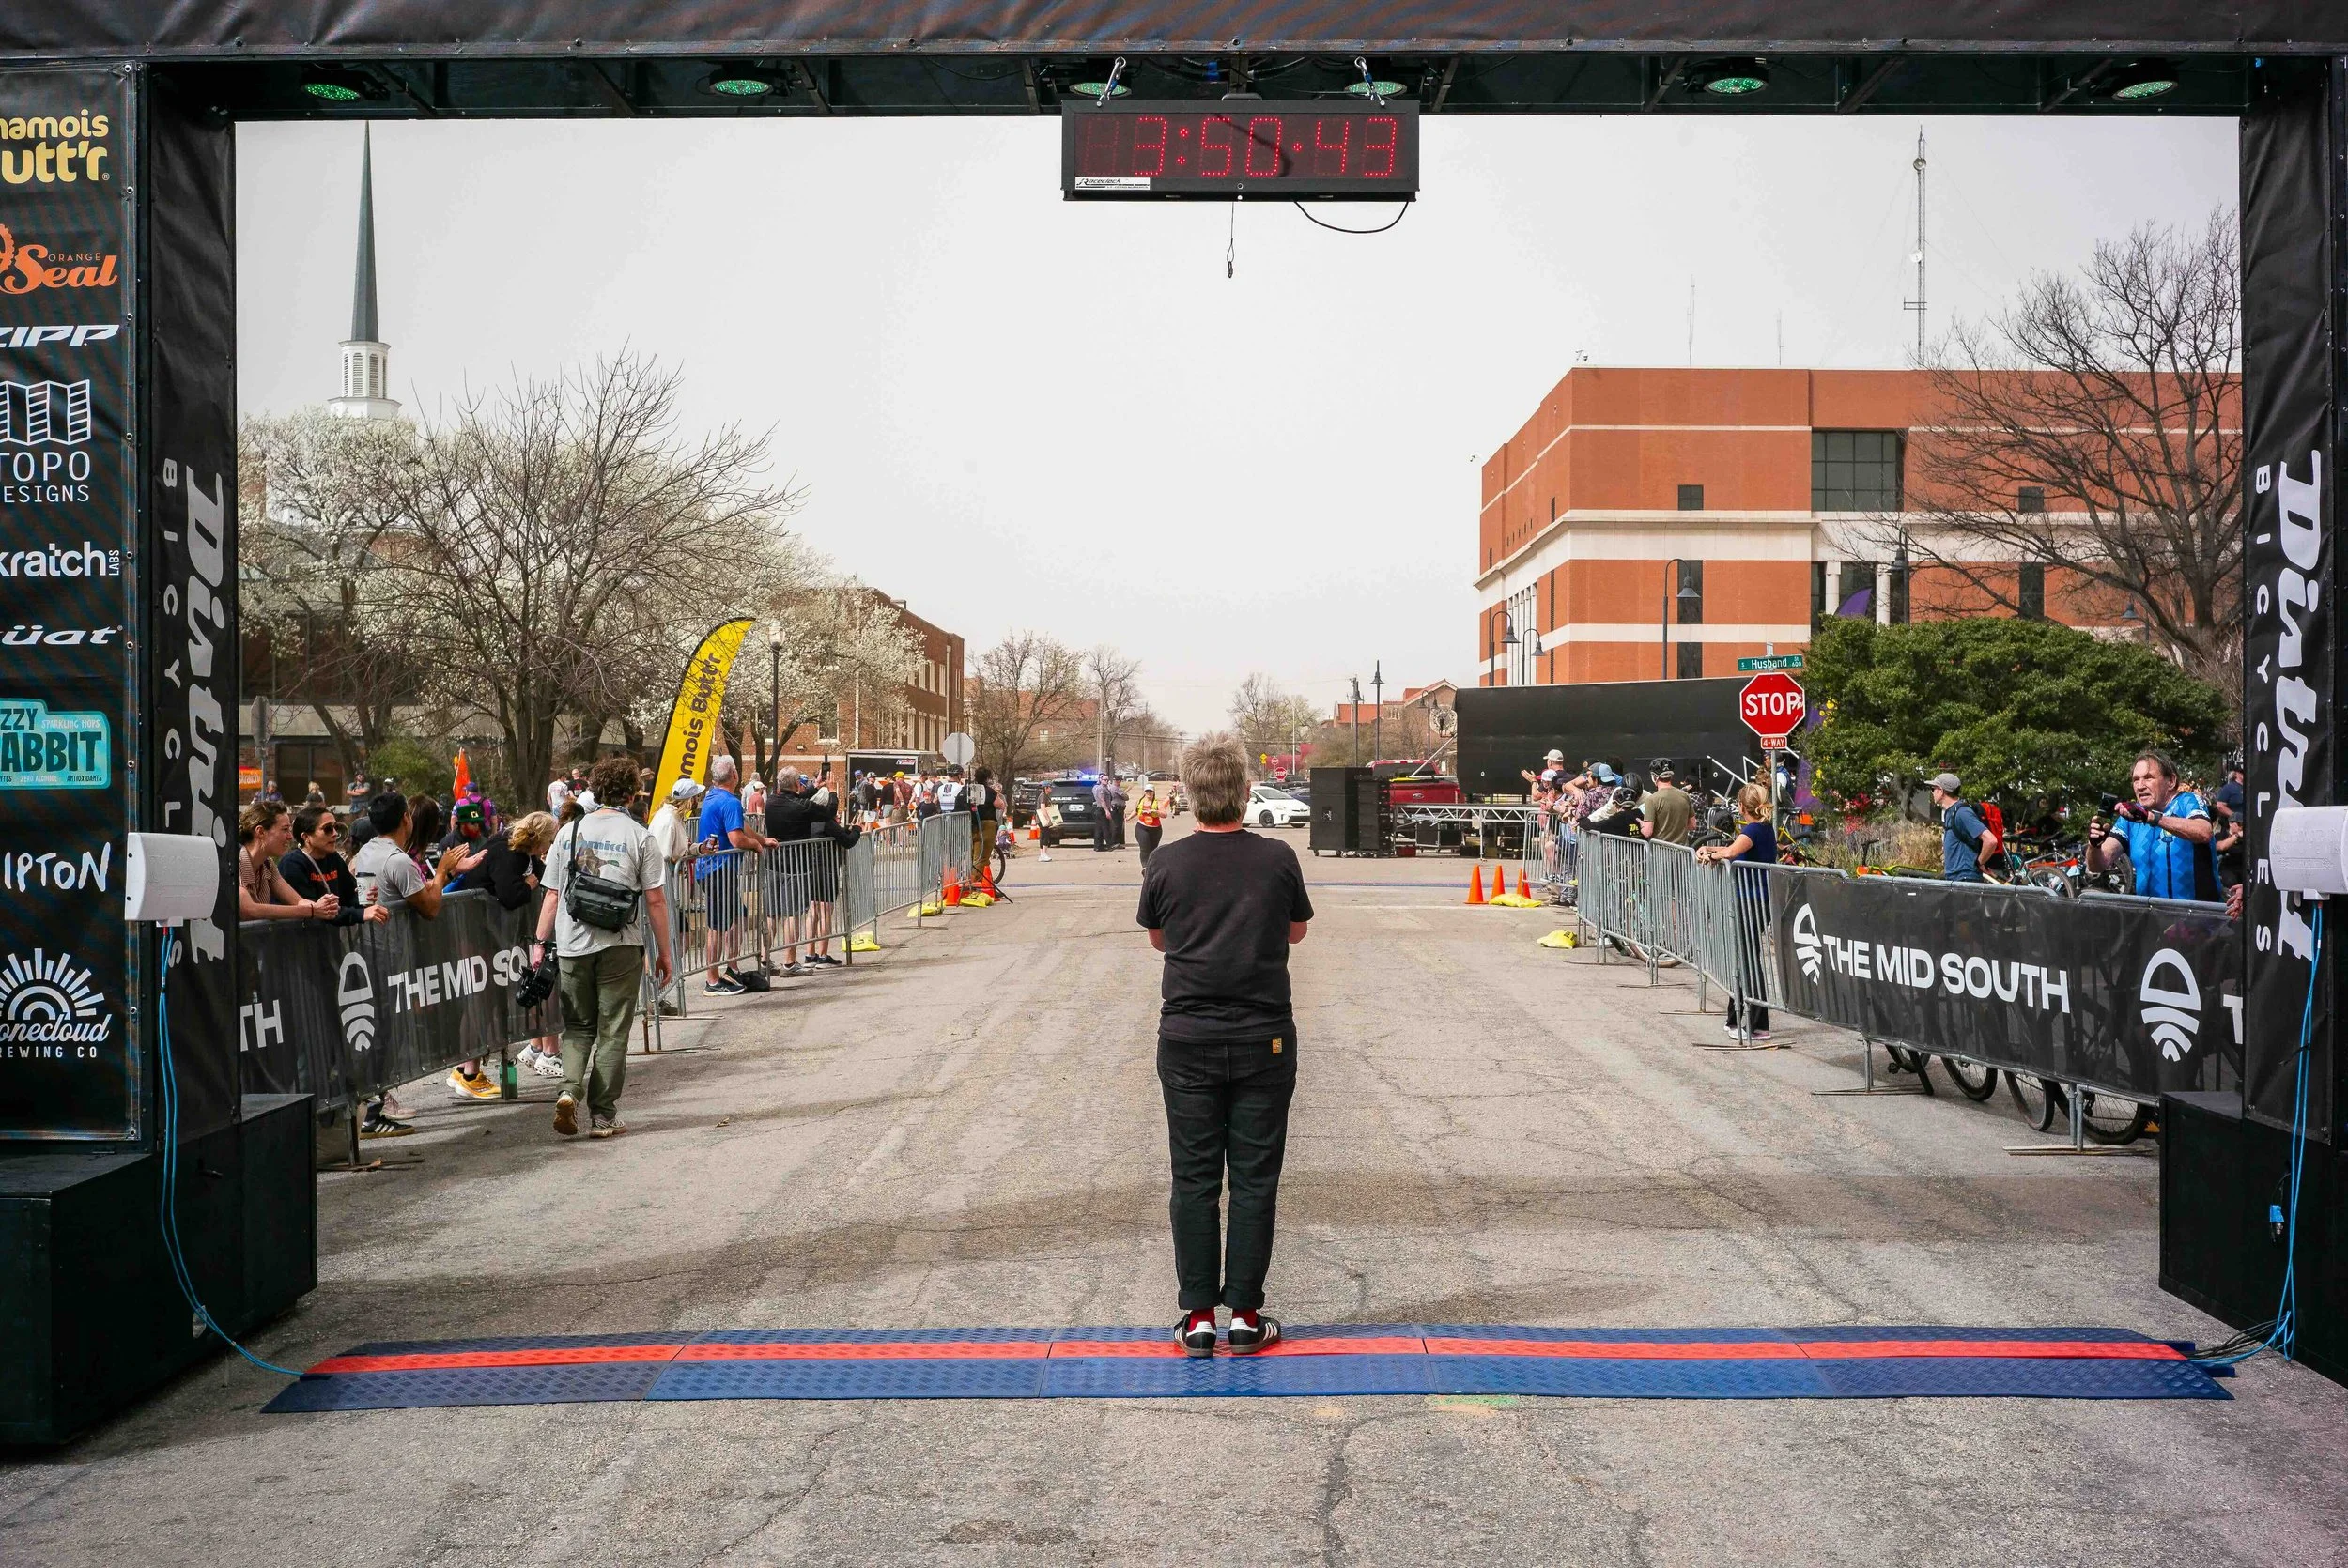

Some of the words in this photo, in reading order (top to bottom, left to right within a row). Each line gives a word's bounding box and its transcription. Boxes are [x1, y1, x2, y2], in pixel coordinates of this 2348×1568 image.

[0, 244, 118, 295] Seal
[48, 252, 101, 262] ORANGE
[108, 549, 120, 576] LABS
[0, 624, 116, 645] üat
[1751, 658, 1787, 669] Husband
[162, 457, 182, 968] BICYCLS
[187, 464, 227, 964] Distrit
[1745, 692, 1801, 717] STOP
[2255, 463, 2271, 953] BICYCLES
[41, 719, 79, 729] SPARKLING
[81, 719, 100, 729] HOPS
[1, 731, 102, 772] ABBIT
[1763, 738, 1784, 747] 4-WAY
[387, 964, 441, 1014] THE
[443, 955, 488, 1001] MID
[1822, 934, 1872, 979] THE
[1876, 944, 1935, 989] MID
[1940, 952, 2071, 1014] SOUTH
[0, 1046, 63, 1058] EWING
[77, 1046, 97, 1058] CO
